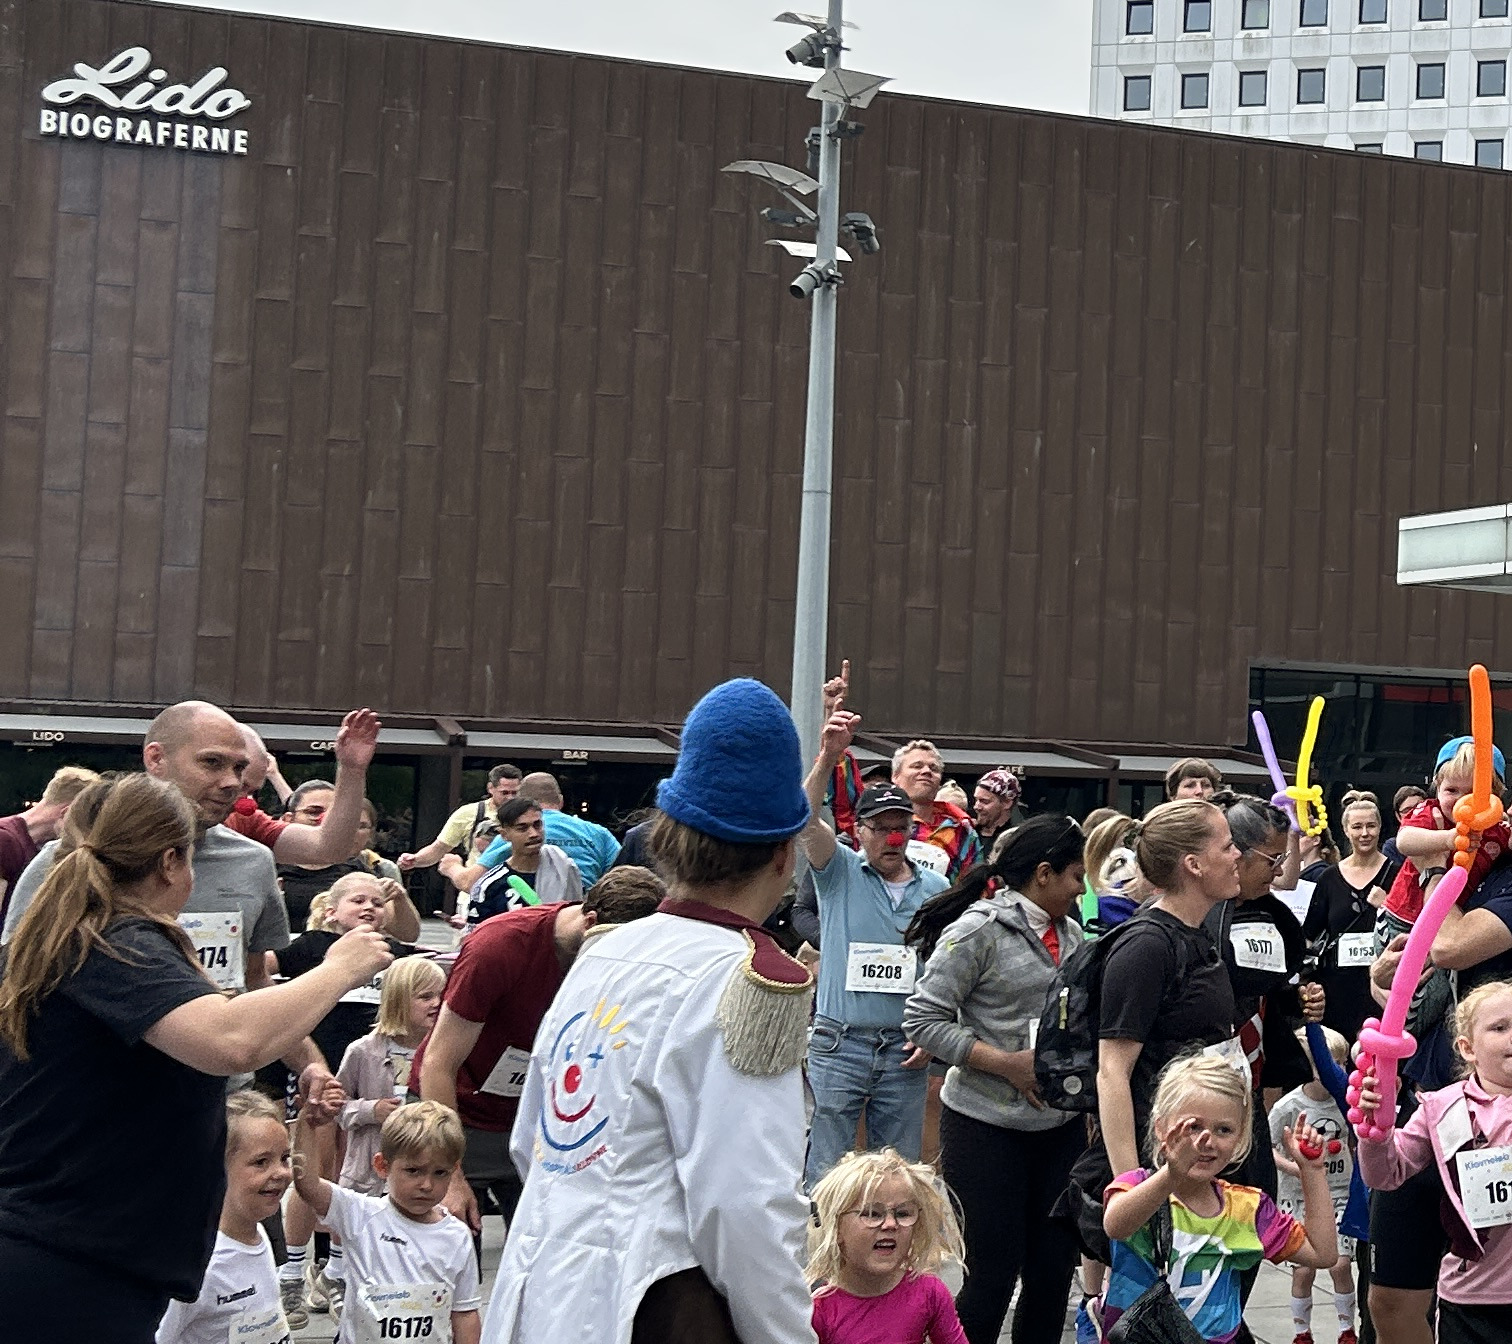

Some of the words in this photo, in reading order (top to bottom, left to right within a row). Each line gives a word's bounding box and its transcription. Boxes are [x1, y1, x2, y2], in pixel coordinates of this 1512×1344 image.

[41, 46, 252, 120] Lido
[39, 108, 250, 156] BIOGRAFERNE
[32, 731, 65, 742] LIDO
[562, 750, 589, 761] BAR
[1244, 938, 1273, 956] 16177
[861, 963, 903, 980] 16208
[377, 1316, 433, 1338] 16173
